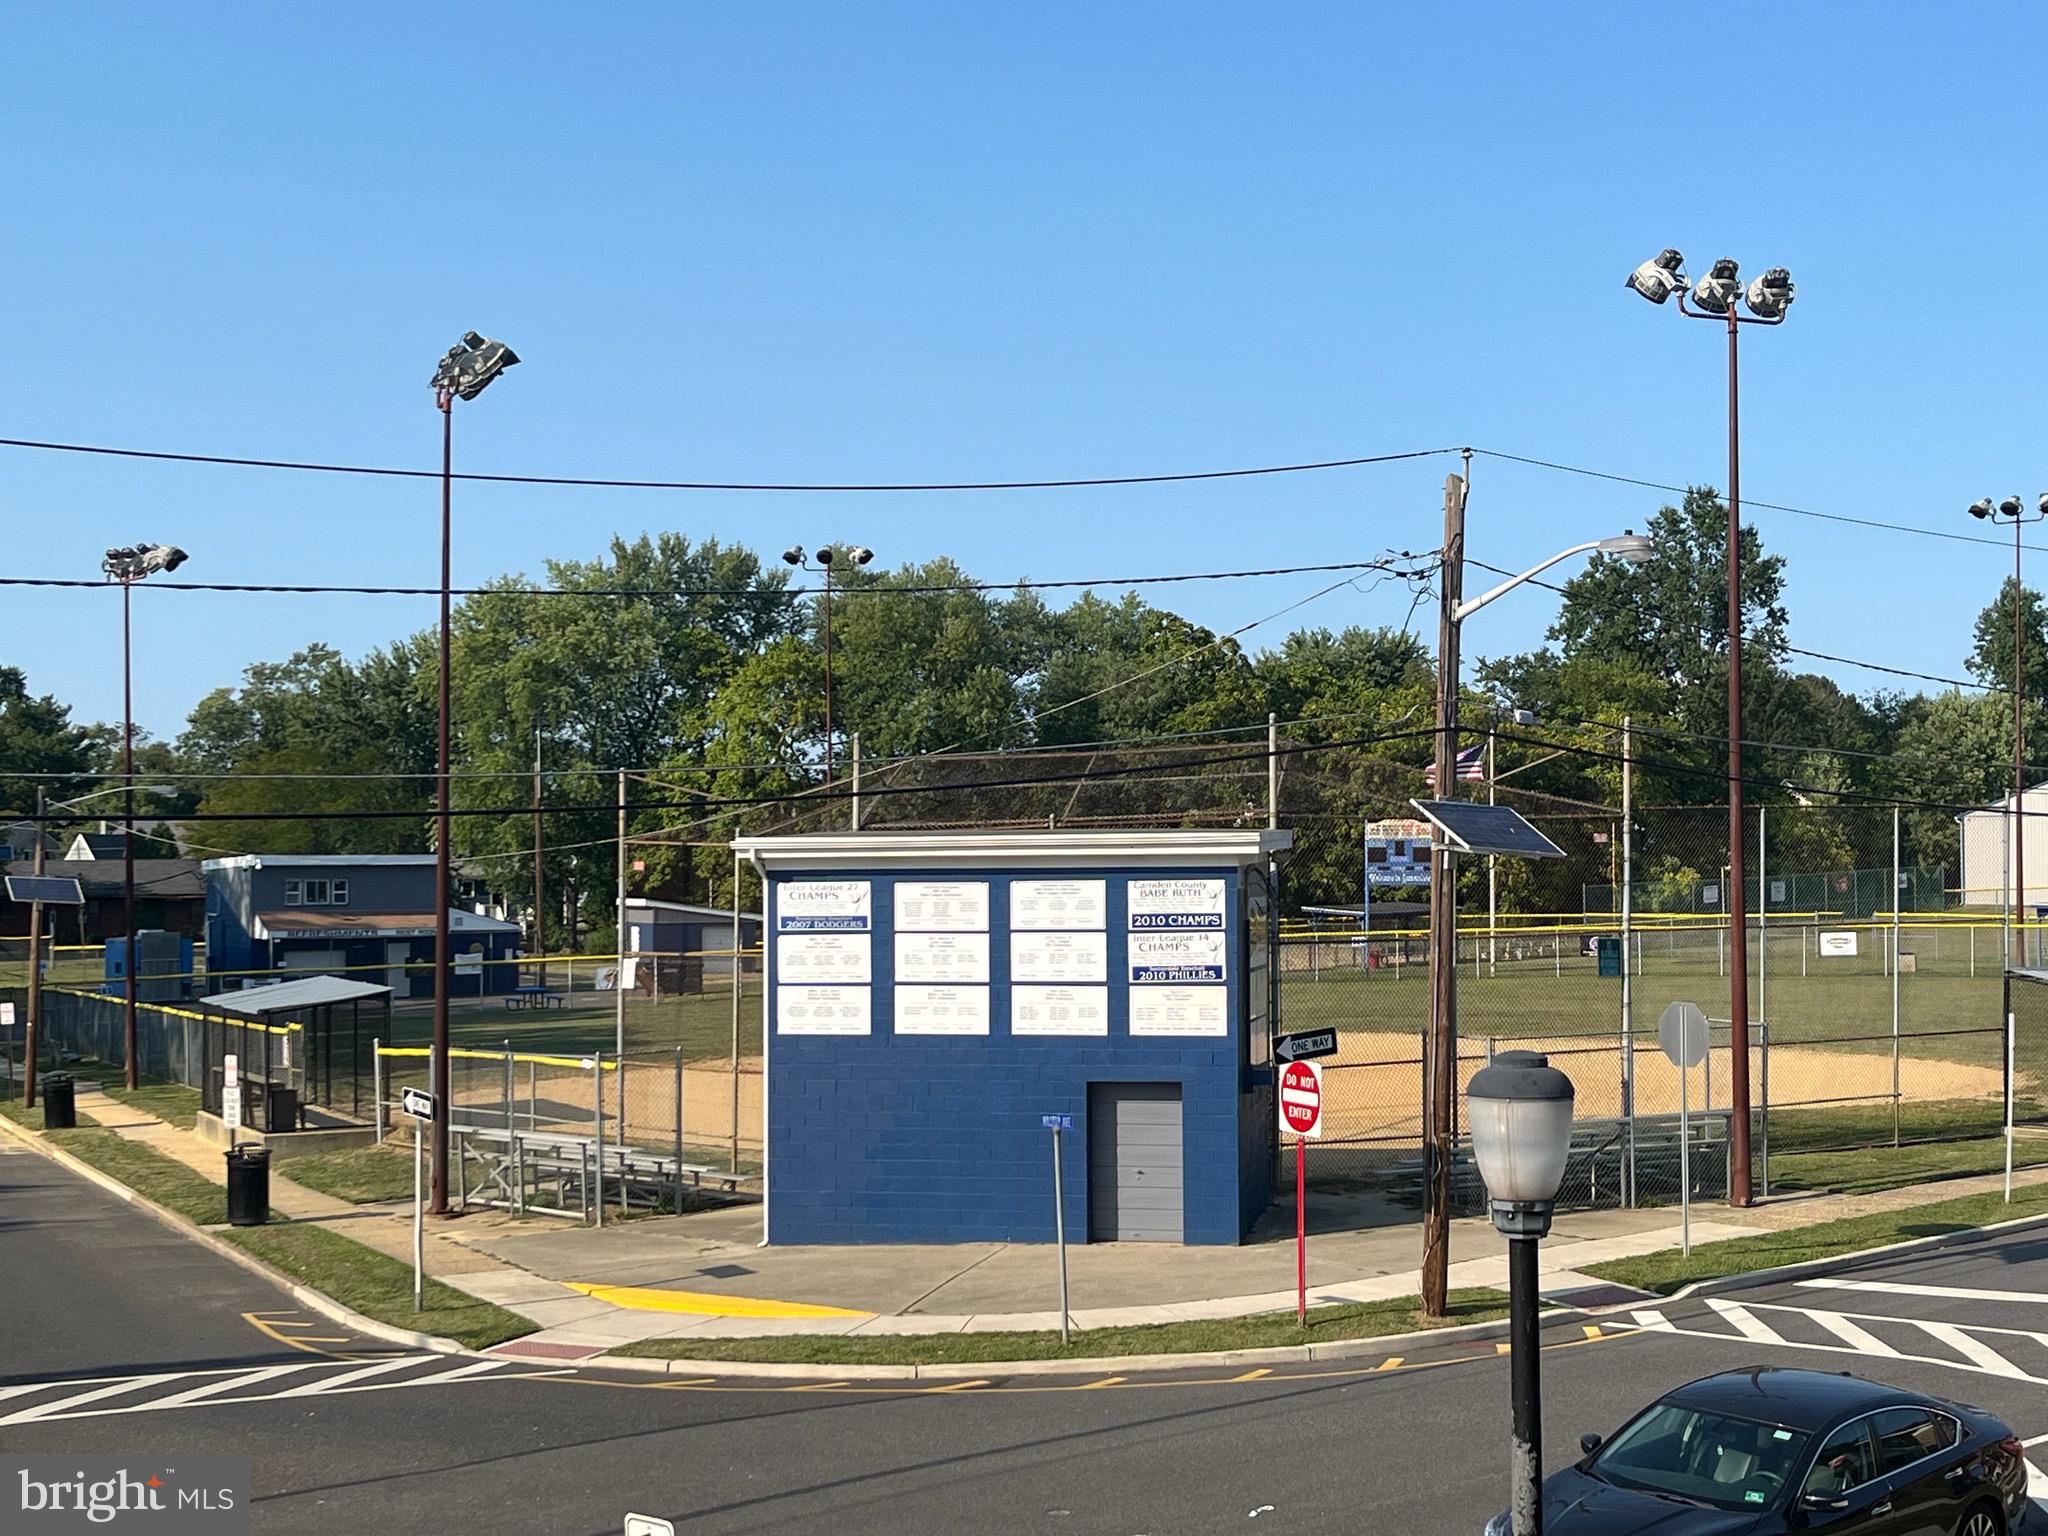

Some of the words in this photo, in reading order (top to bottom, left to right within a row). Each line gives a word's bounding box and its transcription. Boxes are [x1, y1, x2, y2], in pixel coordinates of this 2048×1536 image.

[847, 883, 859, 891] 27
[1133, 881, 1171, 889] Camden
[1174, 881, 1207, 889] County
[789, 892, 839, 900] CHAMPS
[1140, 889, 1168, 897] BABE
[1173, 889, 1201, 897] RUTH
[1134, 916, 1166, 926] 2010
[1168, 915, 1220, 925] CHAMPS
[1199, 933, 1209, 941] 14
[1139, 943, 1190, 952] CHAMPS
[1140, 971, 1166, 980] 2010
[1169, 970, 1216, 980] PHILLIES
[1291, 1040, 1311, 1053] ONE
[1312, 1036, 1330, 1049] WAY
[1286, 1073, 1297, 1086] DO
[1300, 1075, 1315, 1089] NOT
[1288, 1105, 1313, 1121] ENTER
